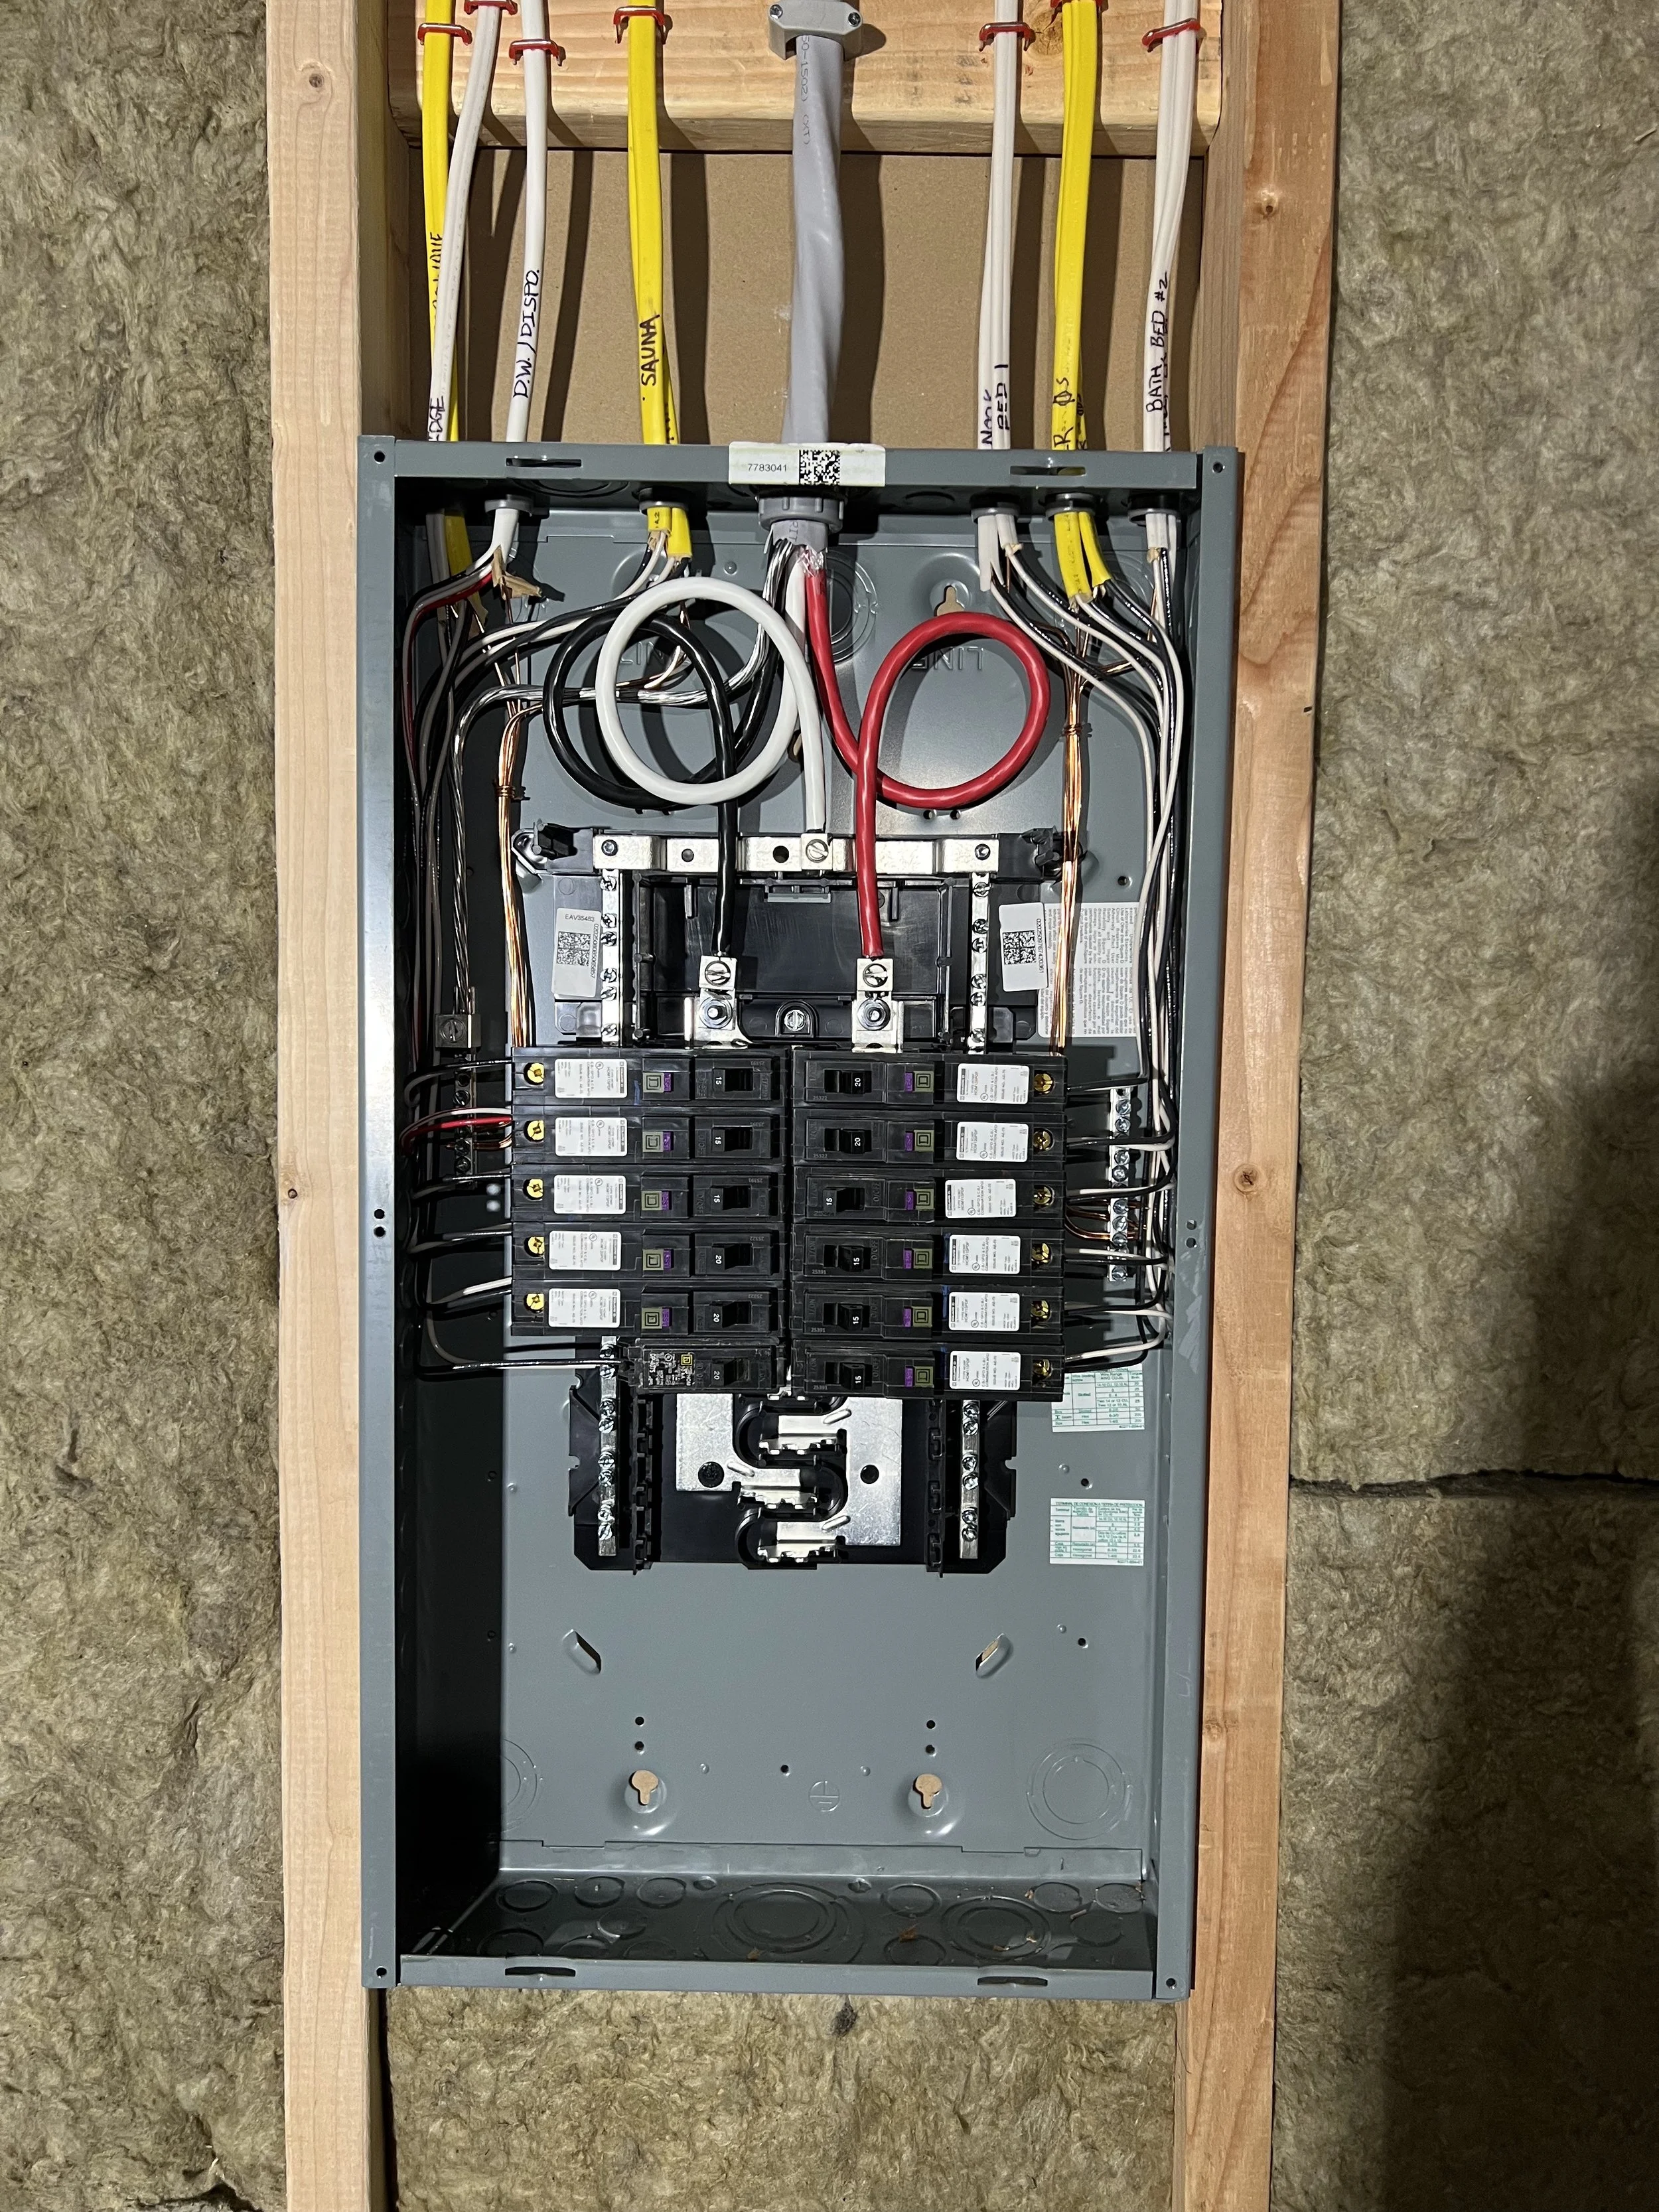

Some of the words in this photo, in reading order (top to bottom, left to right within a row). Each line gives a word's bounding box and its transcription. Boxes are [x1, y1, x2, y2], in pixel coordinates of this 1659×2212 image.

[639, 315, 660, 386] SAUNA
[748, 463, 788, 473] 7783041
[715, 1076, 722, 1085] 15
[854, 1077, 861, 1087] 20
[715, 1136, 721, 1145] 15
[854, 1138, 861, 1147] 20
[714, 1195, 720, 1203] 15
[826, 1197, 833, 1206] 15
[715, 1254, 721, 1264] 20
[853, 1257, 860, 1266] 15
[713, 1313, 719, 1323] 20
[853, 1315, 859, 1325] 15
[714, 1370, 720, 1380] 20
[855, 1375, 861, 1384] 15
